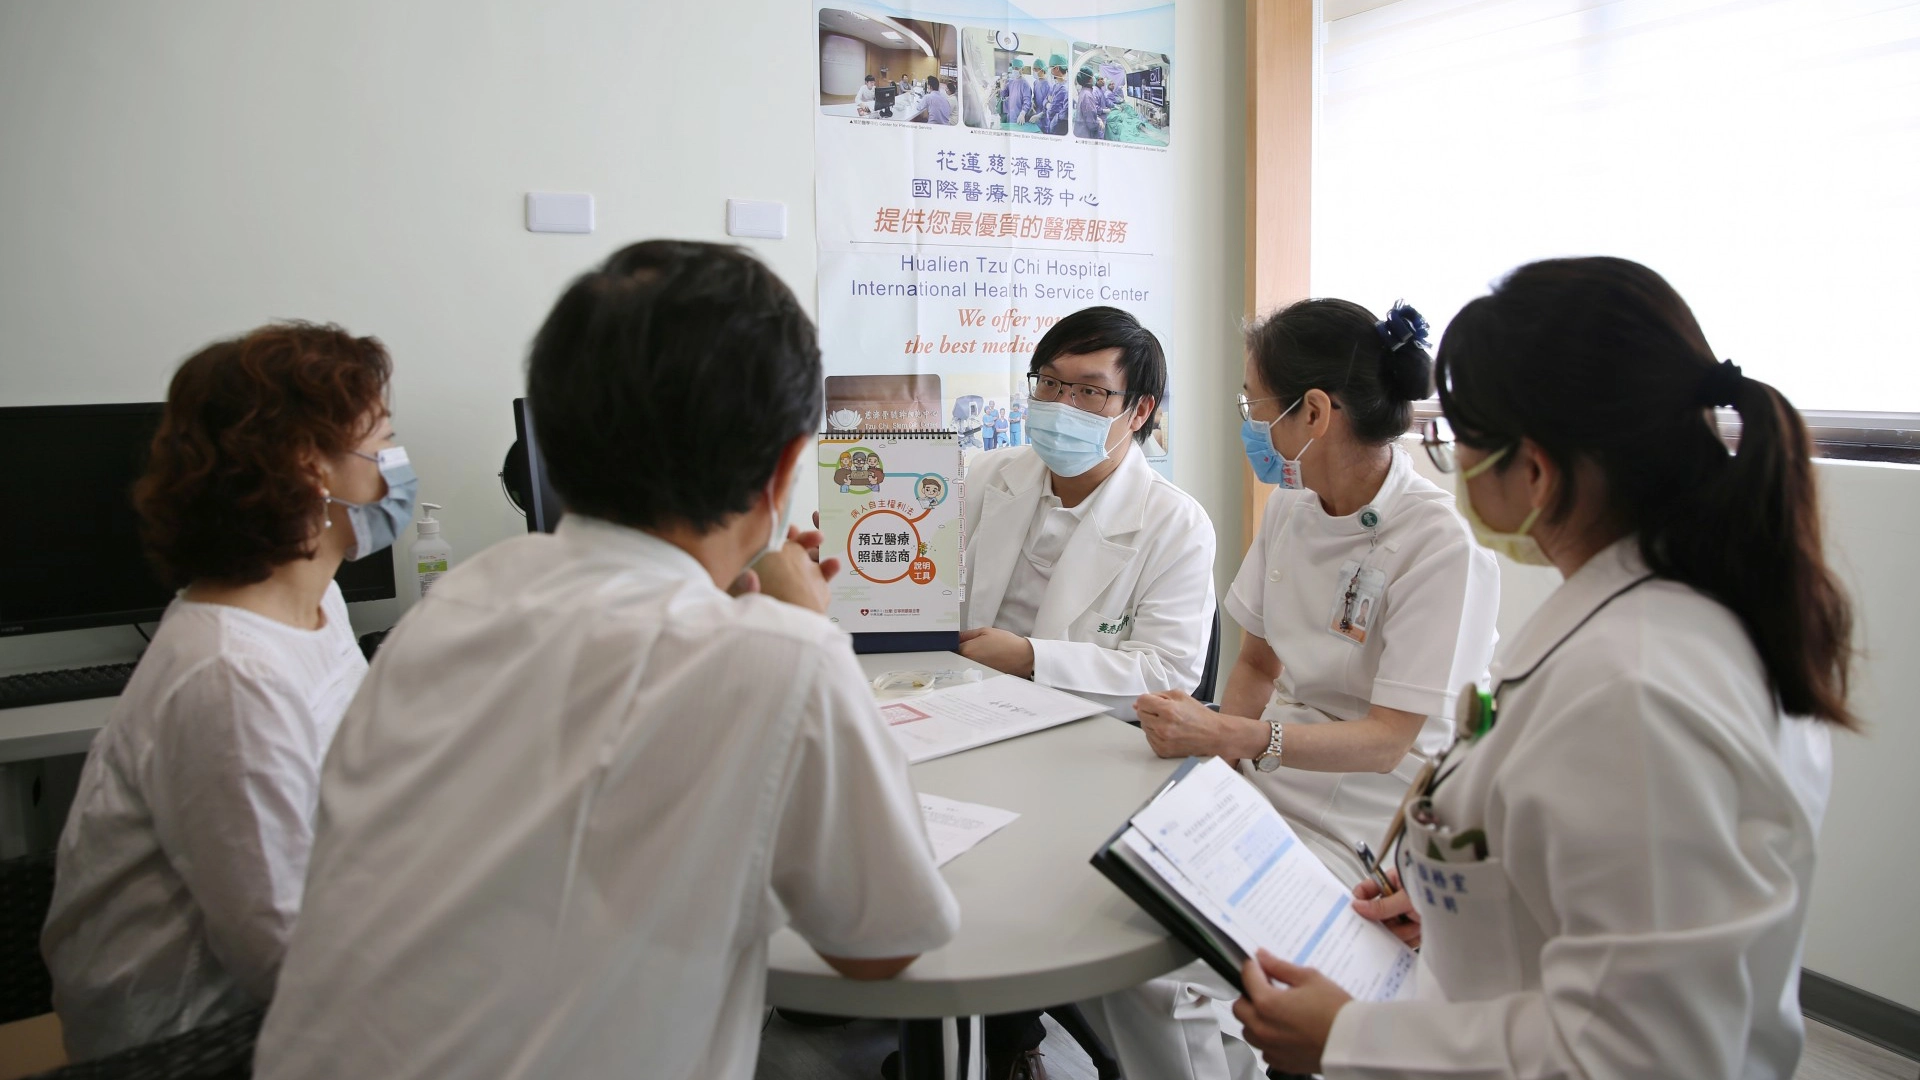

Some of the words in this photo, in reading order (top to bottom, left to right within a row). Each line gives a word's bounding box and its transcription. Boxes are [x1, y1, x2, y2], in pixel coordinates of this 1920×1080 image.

[937, 150, 1076, 181] 花蓮慈濟醫院
[912, 178, 1099, 207] 國際醫療服務中心
[873, 207, 1128, 244] 提供您最優質的醫療服務
[901, 255, 969, 274] Hualien
[976, 256, 1008, 274] Tzu
[1013, 257, 1040, 275] Chi
[1047, 259, 1111, 280] Hospital
[852, 279, 967, 298] International
[974, 281, 1028, 299] Health
[1034, 282, 1094, 301] Service
[1100, 285, 1149, 302] Center
[957, 307, 986, 328] We
[991, 307, 1031, 334] offer
[904, 334, 935, 354] the
[939, 334, 976, 354] best
[982, 334, 1038, 354] medic
[850, 498, 915, 520] 病人自主權利法
[858, 531, 910, 546] 預立醫療
[858, 549, 910, 563] 照護諮商
[913, 561, 931, 571] 說明
[913, 571, 931, 581] 工具
